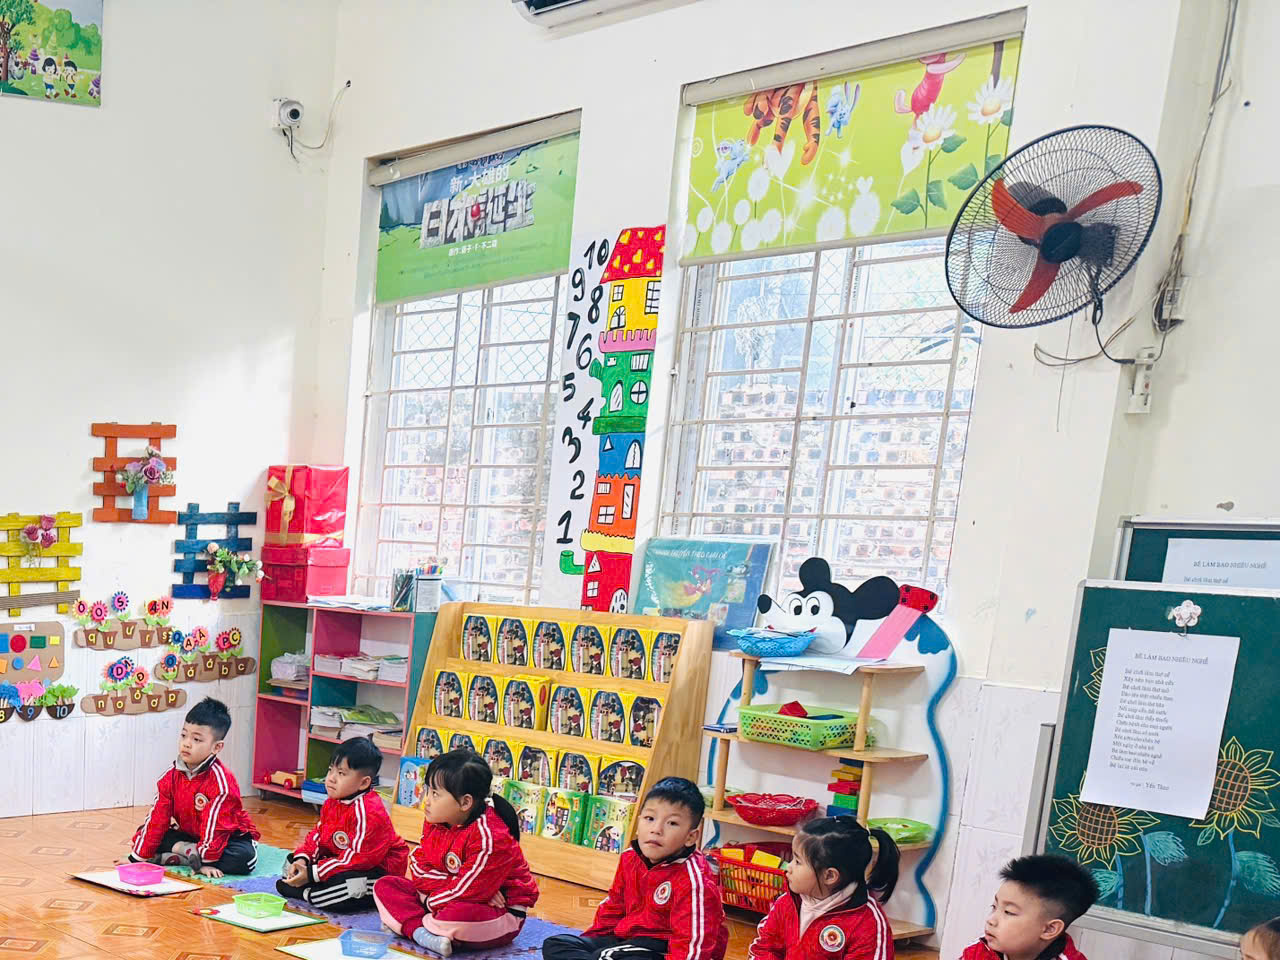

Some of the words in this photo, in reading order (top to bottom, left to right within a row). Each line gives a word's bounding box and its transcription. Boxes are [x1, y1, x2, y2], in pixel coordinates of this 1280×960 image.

[583, 239, 609, 270] 10
[572, 267, 586, 302] 9
[588, 285, 604, 324] 8
[567, 311, 581, 350] 7
[576, 333, 592, 370] 6
[562, 372, 576, 402] 5
[577, 397, 592, 430] 4
[562, 426, 582, 464] 3
[570, 470, 585, 500] 2
[556, 510, 574, 544] 1
[117, 597, 124, 607] S
[161, 601, 169, 611] N
[88, 633, 96, 644] q
[231, 633, 238, 642] C
[222, 665, 228, 675] b
[238, 663, 245, 671] c
[27, 707, 35, 719] 9
[55, 705, 68, 717] 10
[98, 700, 104, 708] n
[168, 693, 176, 703] p
